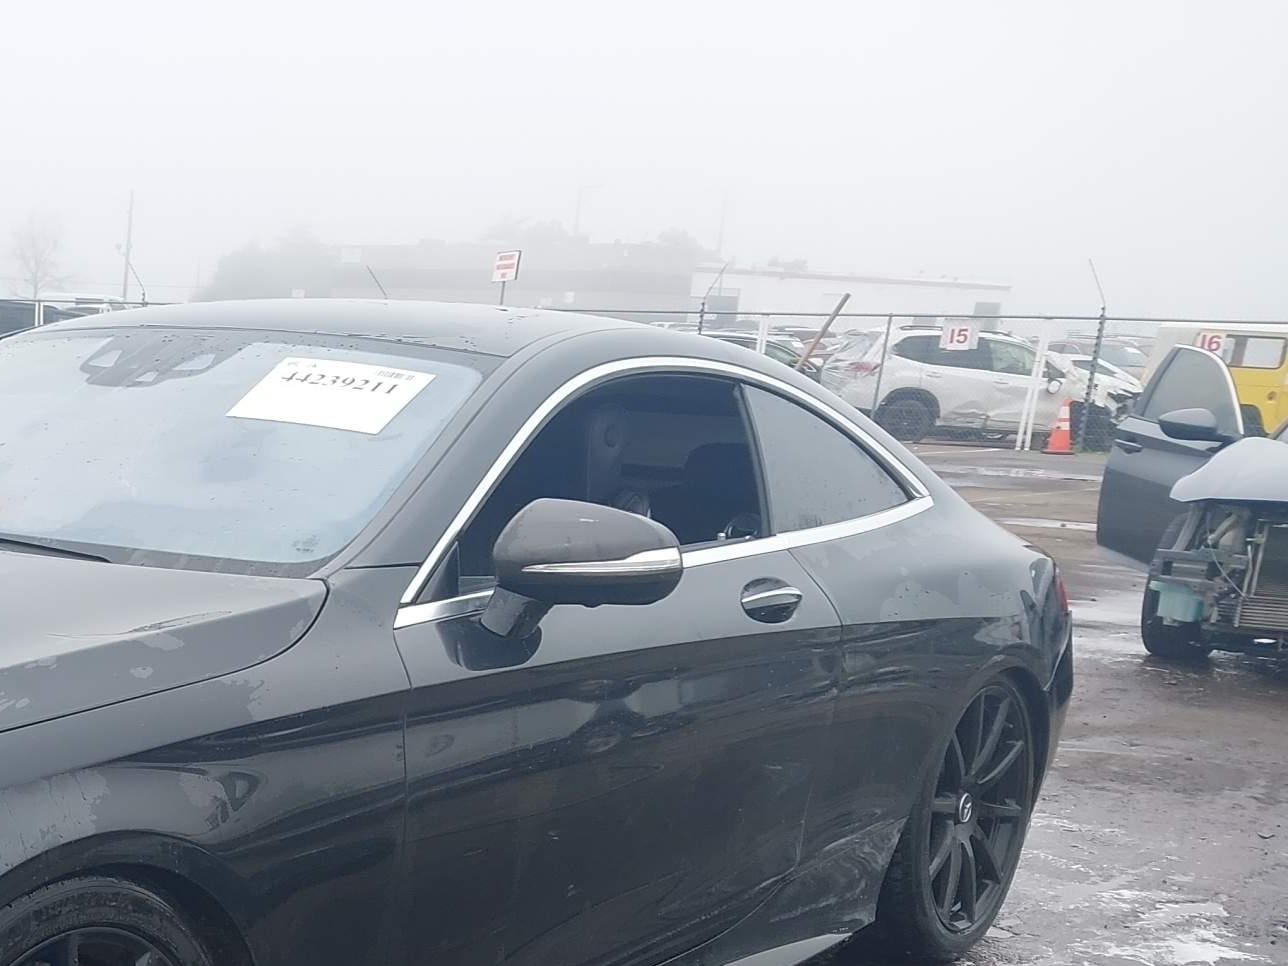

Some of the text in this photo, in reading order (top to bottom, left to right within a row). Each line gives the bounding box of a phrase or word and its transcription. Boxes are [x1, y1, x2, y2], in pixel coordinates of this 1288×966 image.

[949, 328, 969, 345] 15
[1200, 334, 1222, 352] 16
[280, 371, 399, 394] 44239211
